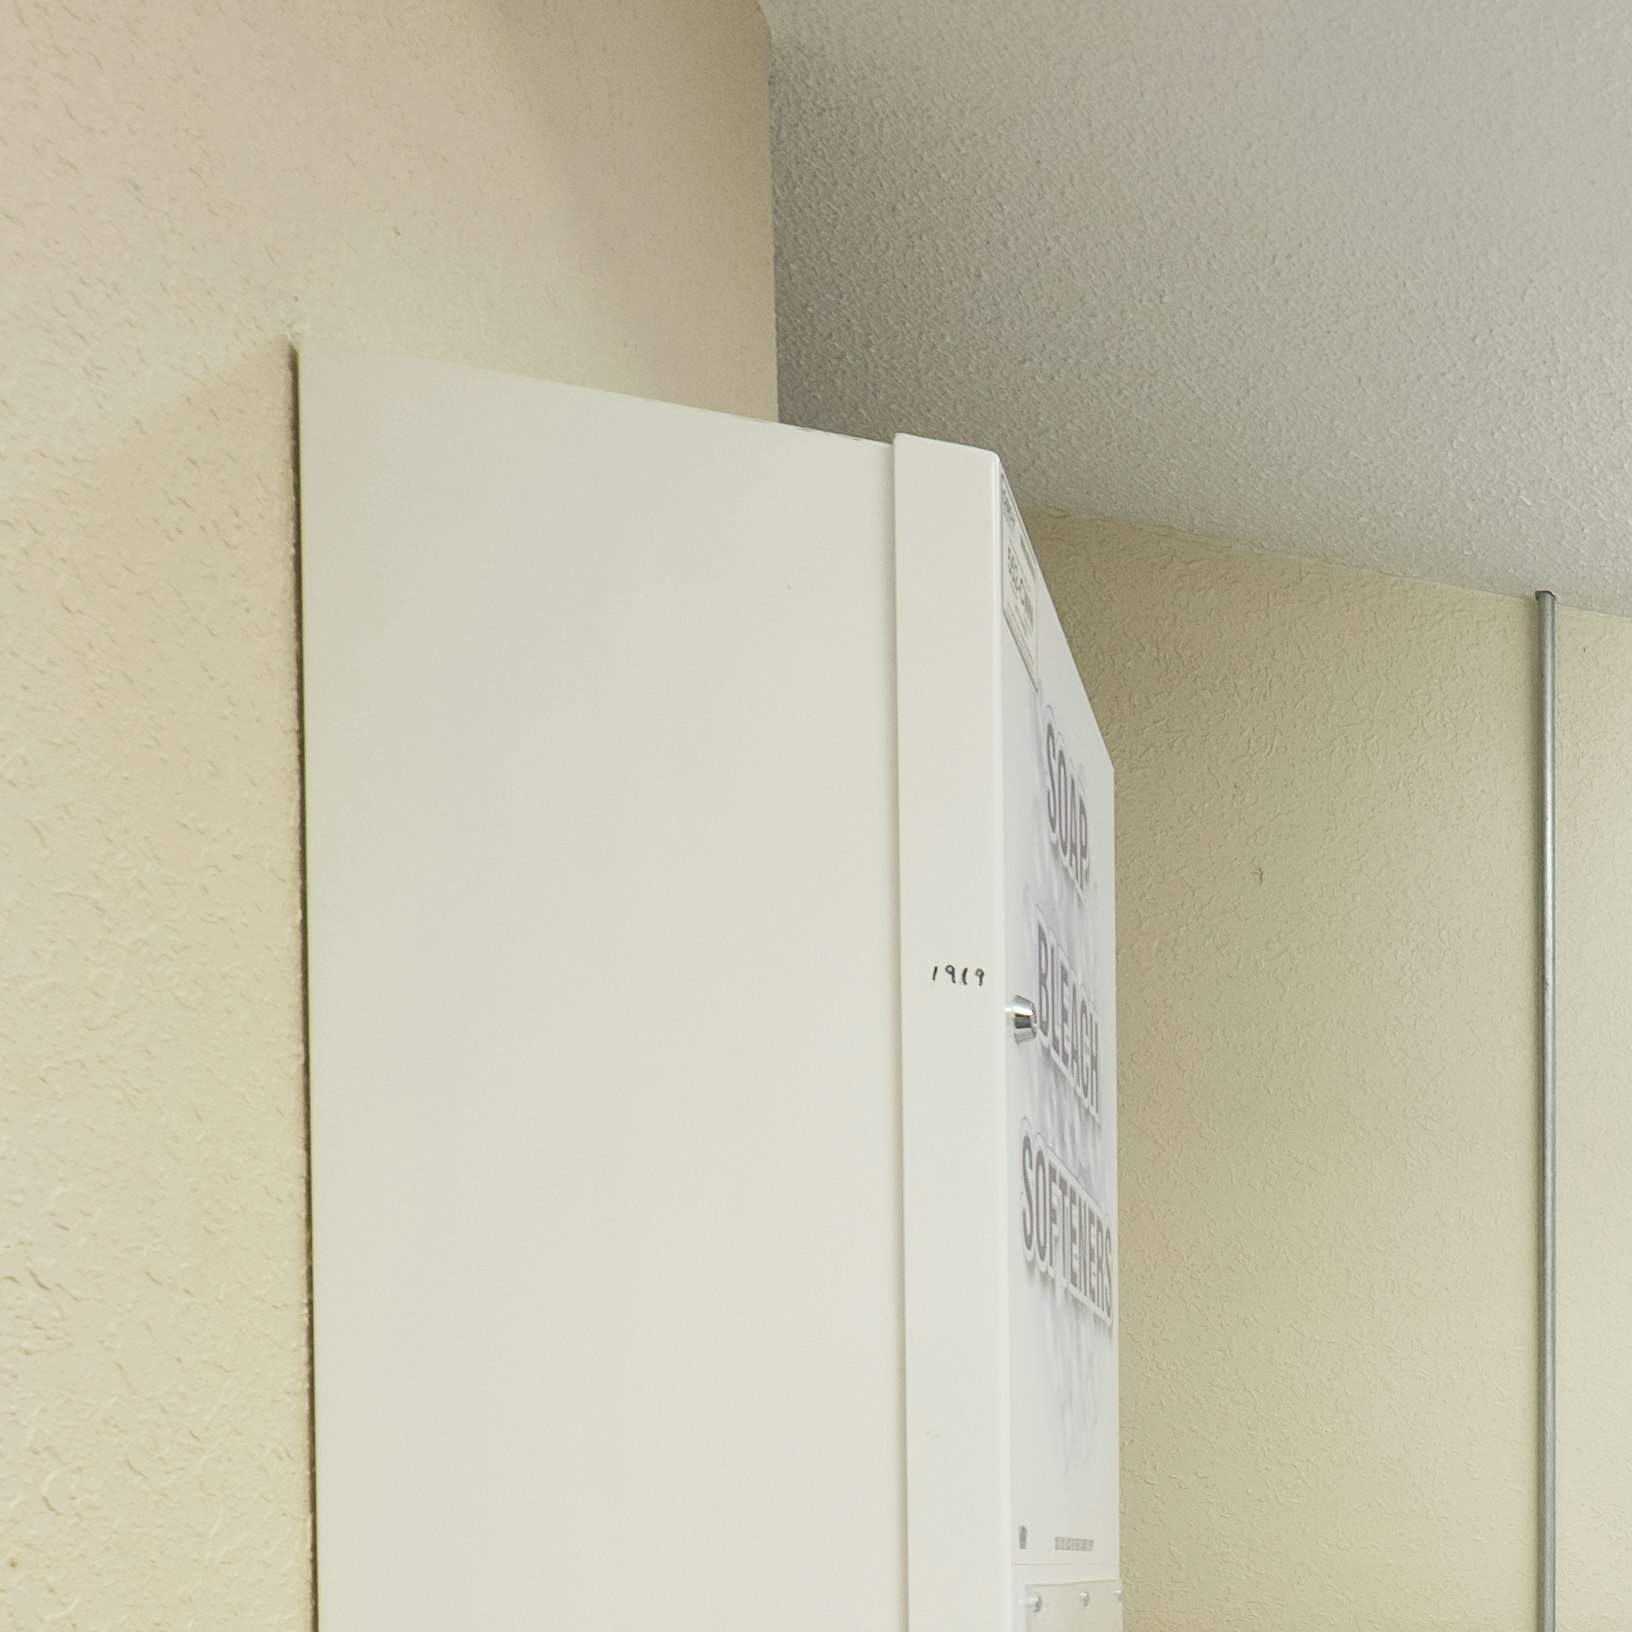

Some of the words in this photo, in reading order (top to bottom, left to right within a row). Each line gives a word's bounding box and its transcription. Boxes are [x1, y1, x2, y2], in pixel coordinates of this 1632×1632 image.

[1046, 721, 1089, 890] SOAP
[1036, 918, 1100, 1116] BLEACH
[1021, 1132, 1113, 1320] SOFTENERS
